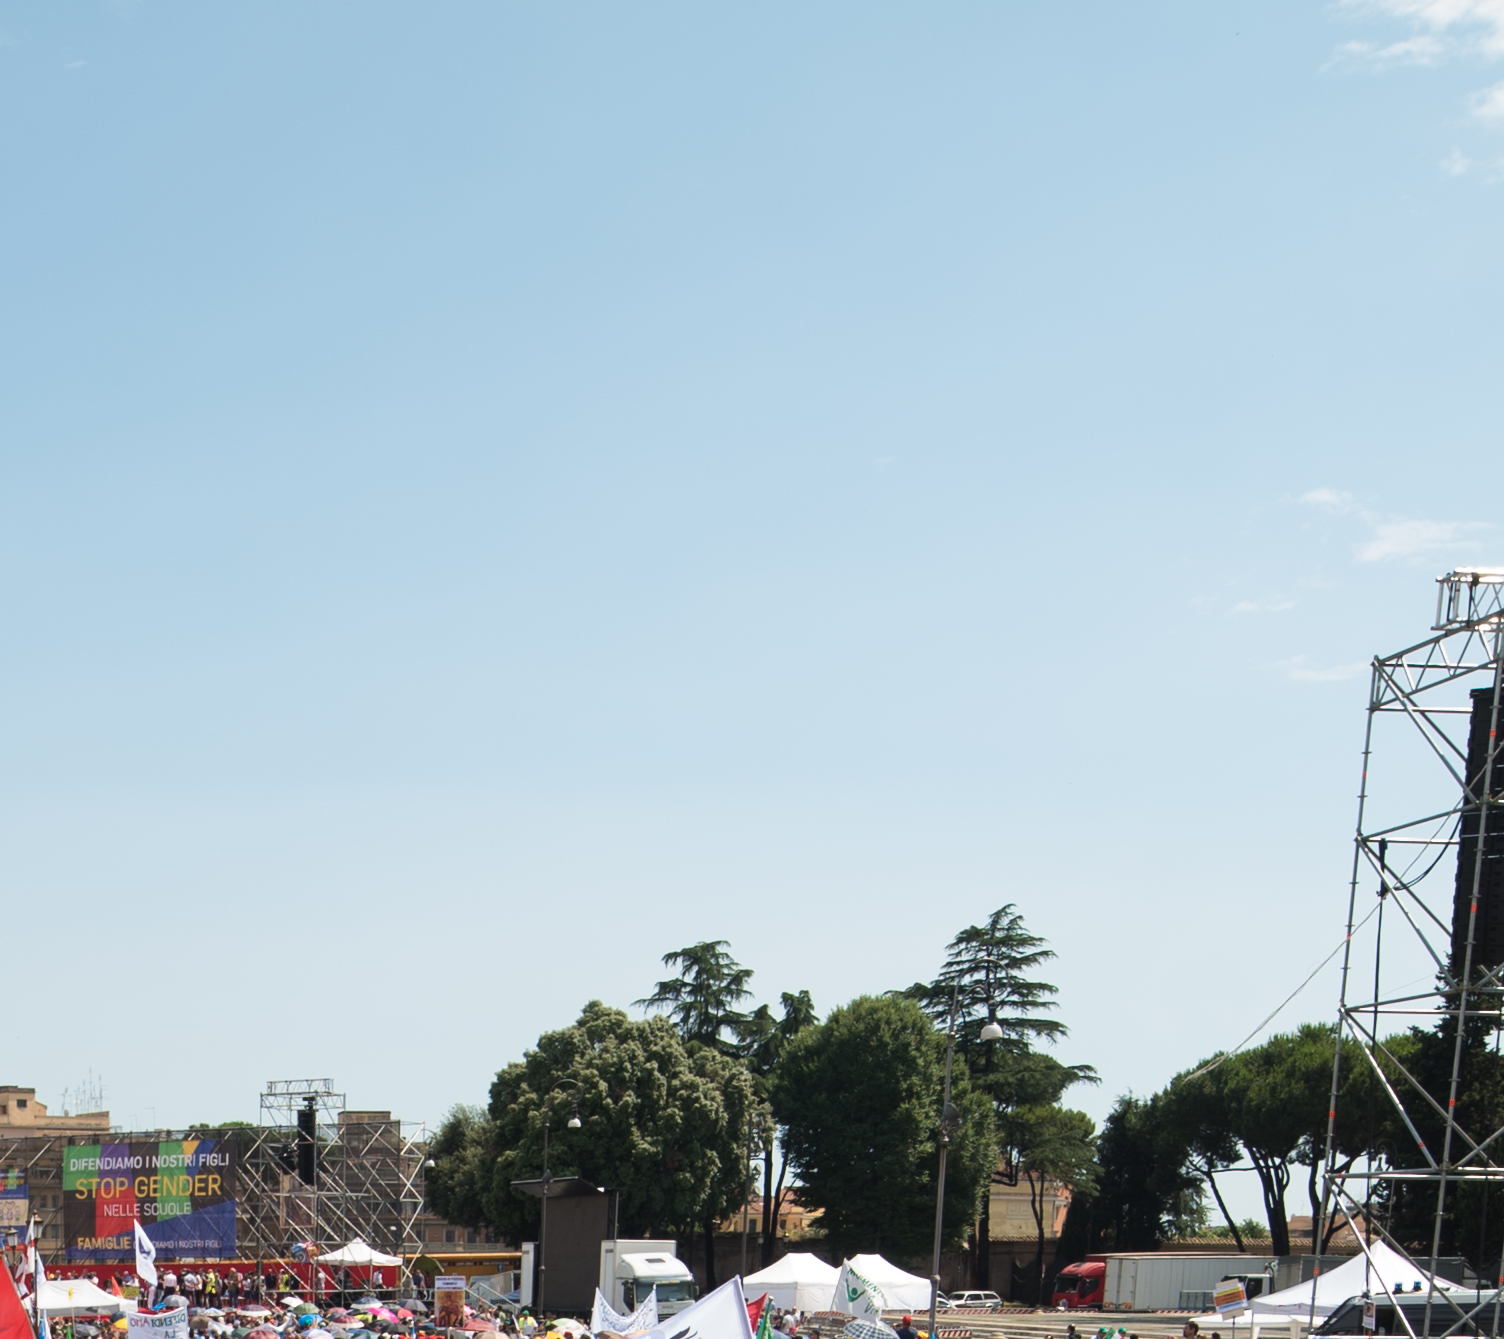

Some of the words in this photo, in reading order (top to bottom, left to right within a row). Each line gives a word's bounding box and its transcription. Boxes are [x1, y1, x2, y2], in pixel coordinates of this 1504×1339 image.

[70, 1156, 143, 1172] DIFENDIAMO
[145, 1156, 149, 1168] I
[152, 1154, 196, 1169] NOSTRI
[199, 1153, 229, 1167] FIGLI
[75, 1177, 129, 1200] STOP
[134, 1174, 222, 1198] GENDER
[104, 1203, 141, 1217] NELLE
[144, 1202, 192, 1216] SCUOLE
[77, 1236, 132, 1250] FAMIGLIE
